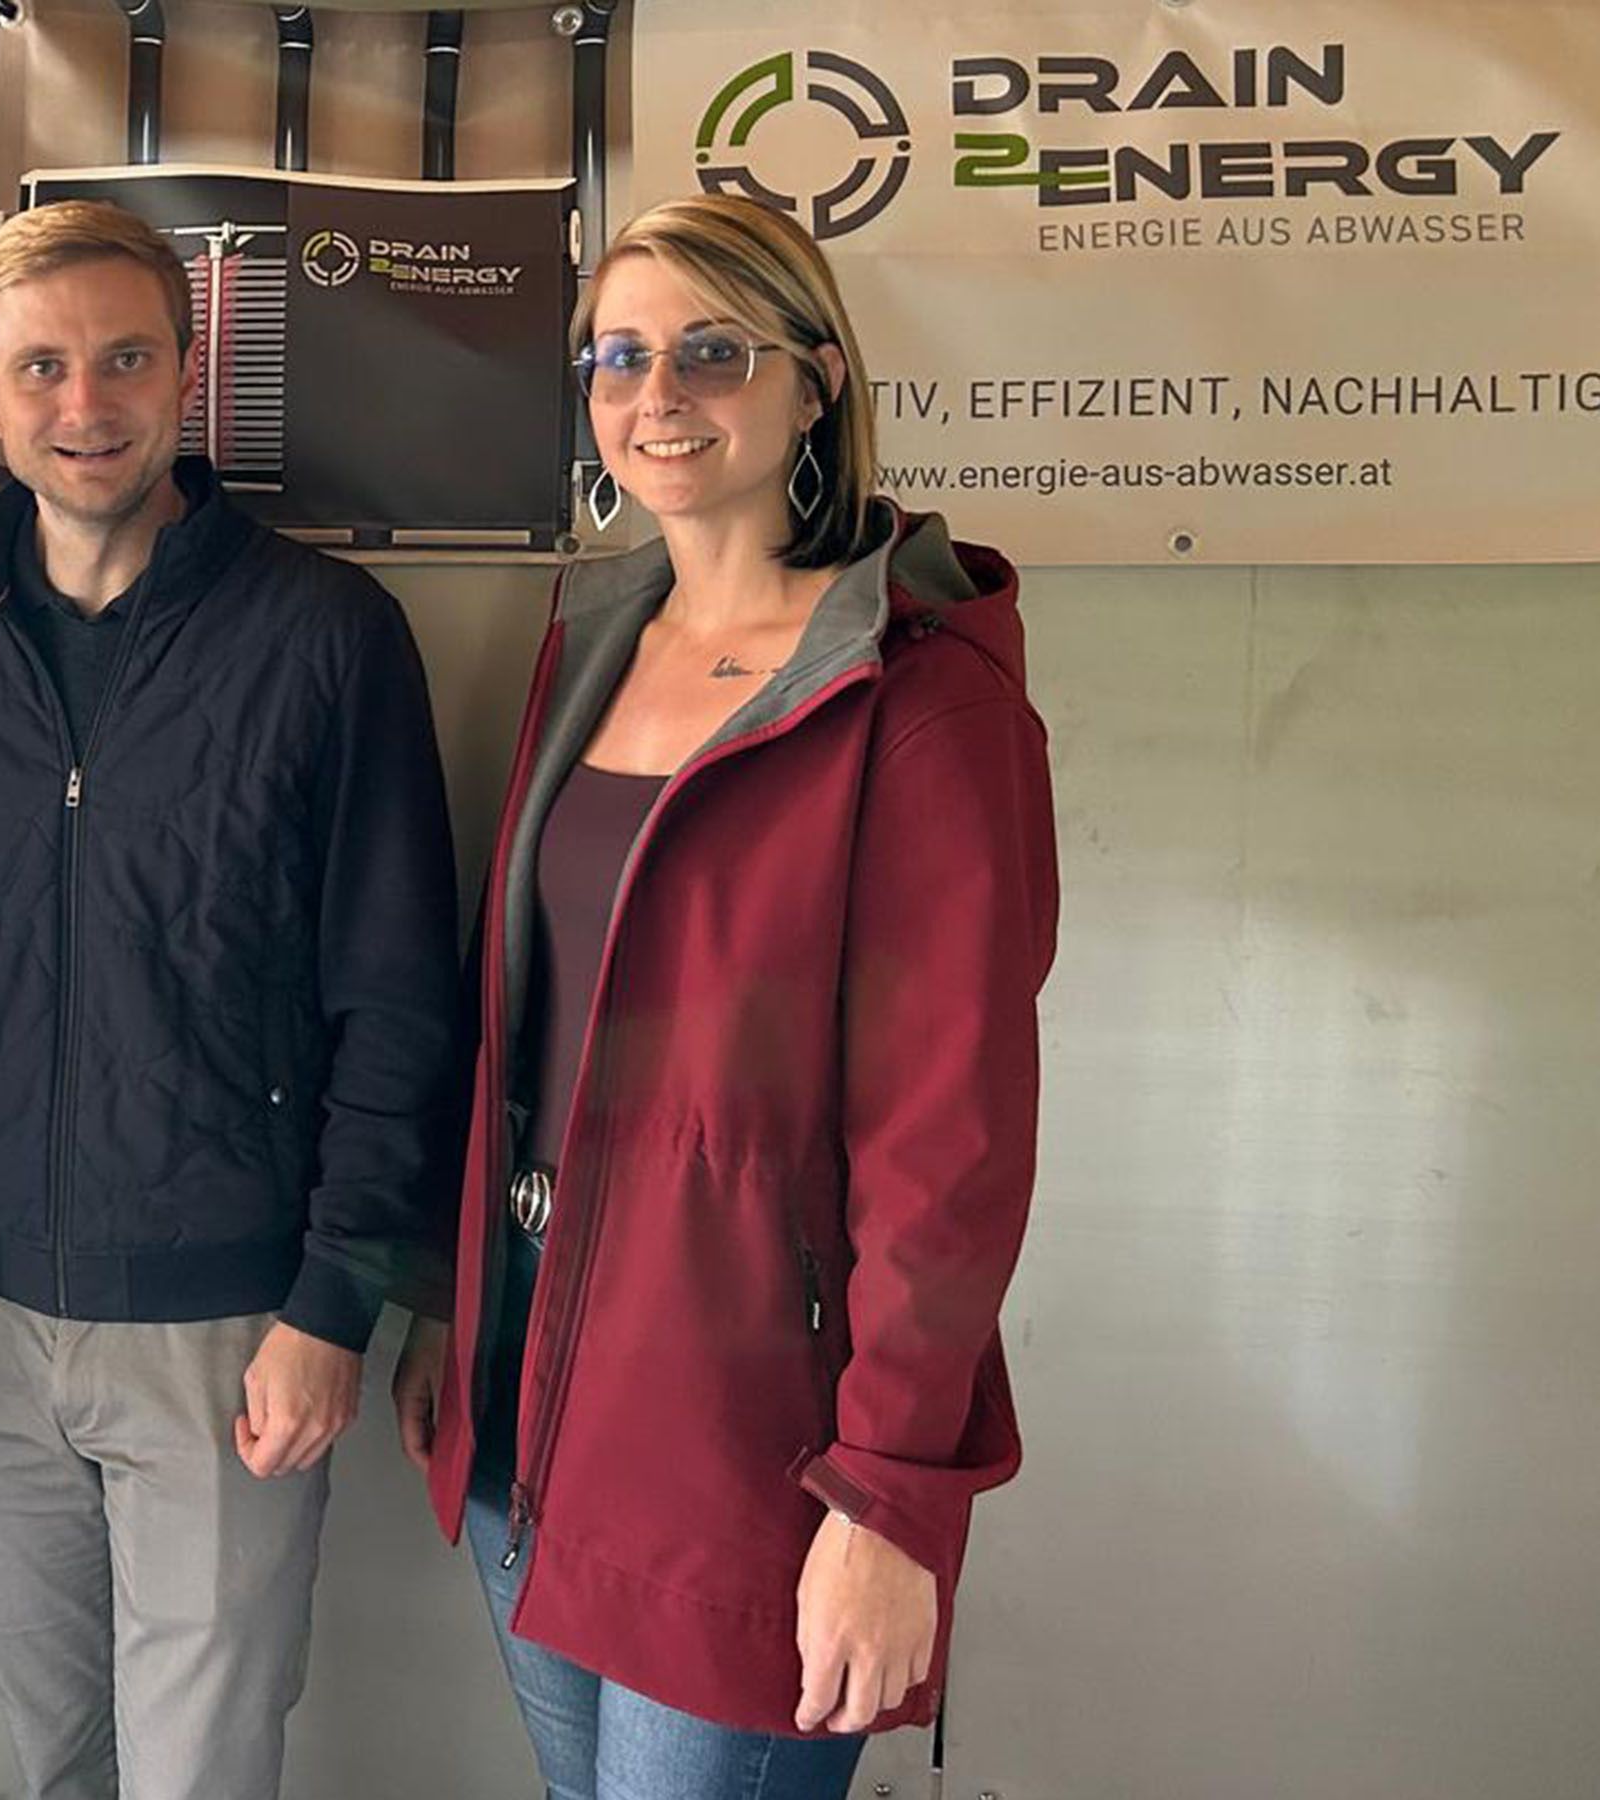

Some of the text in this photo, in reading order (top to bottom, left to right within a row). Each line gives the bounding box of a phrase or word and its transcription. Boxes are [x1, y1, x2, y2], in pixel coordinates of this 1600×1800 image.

[952, 43, 1345, 116] DRAIN
[952, 131, 1562, 207] 2ENERGY
[368, 239, 470, 261] DRAIN
[1038, 213, 1526, 251] ENERGIE AUS ABWASSER
[970, 376, 1241, 422] EFFIZIENT,
[1262, 372, 1600, 416] NACHHALTIG
